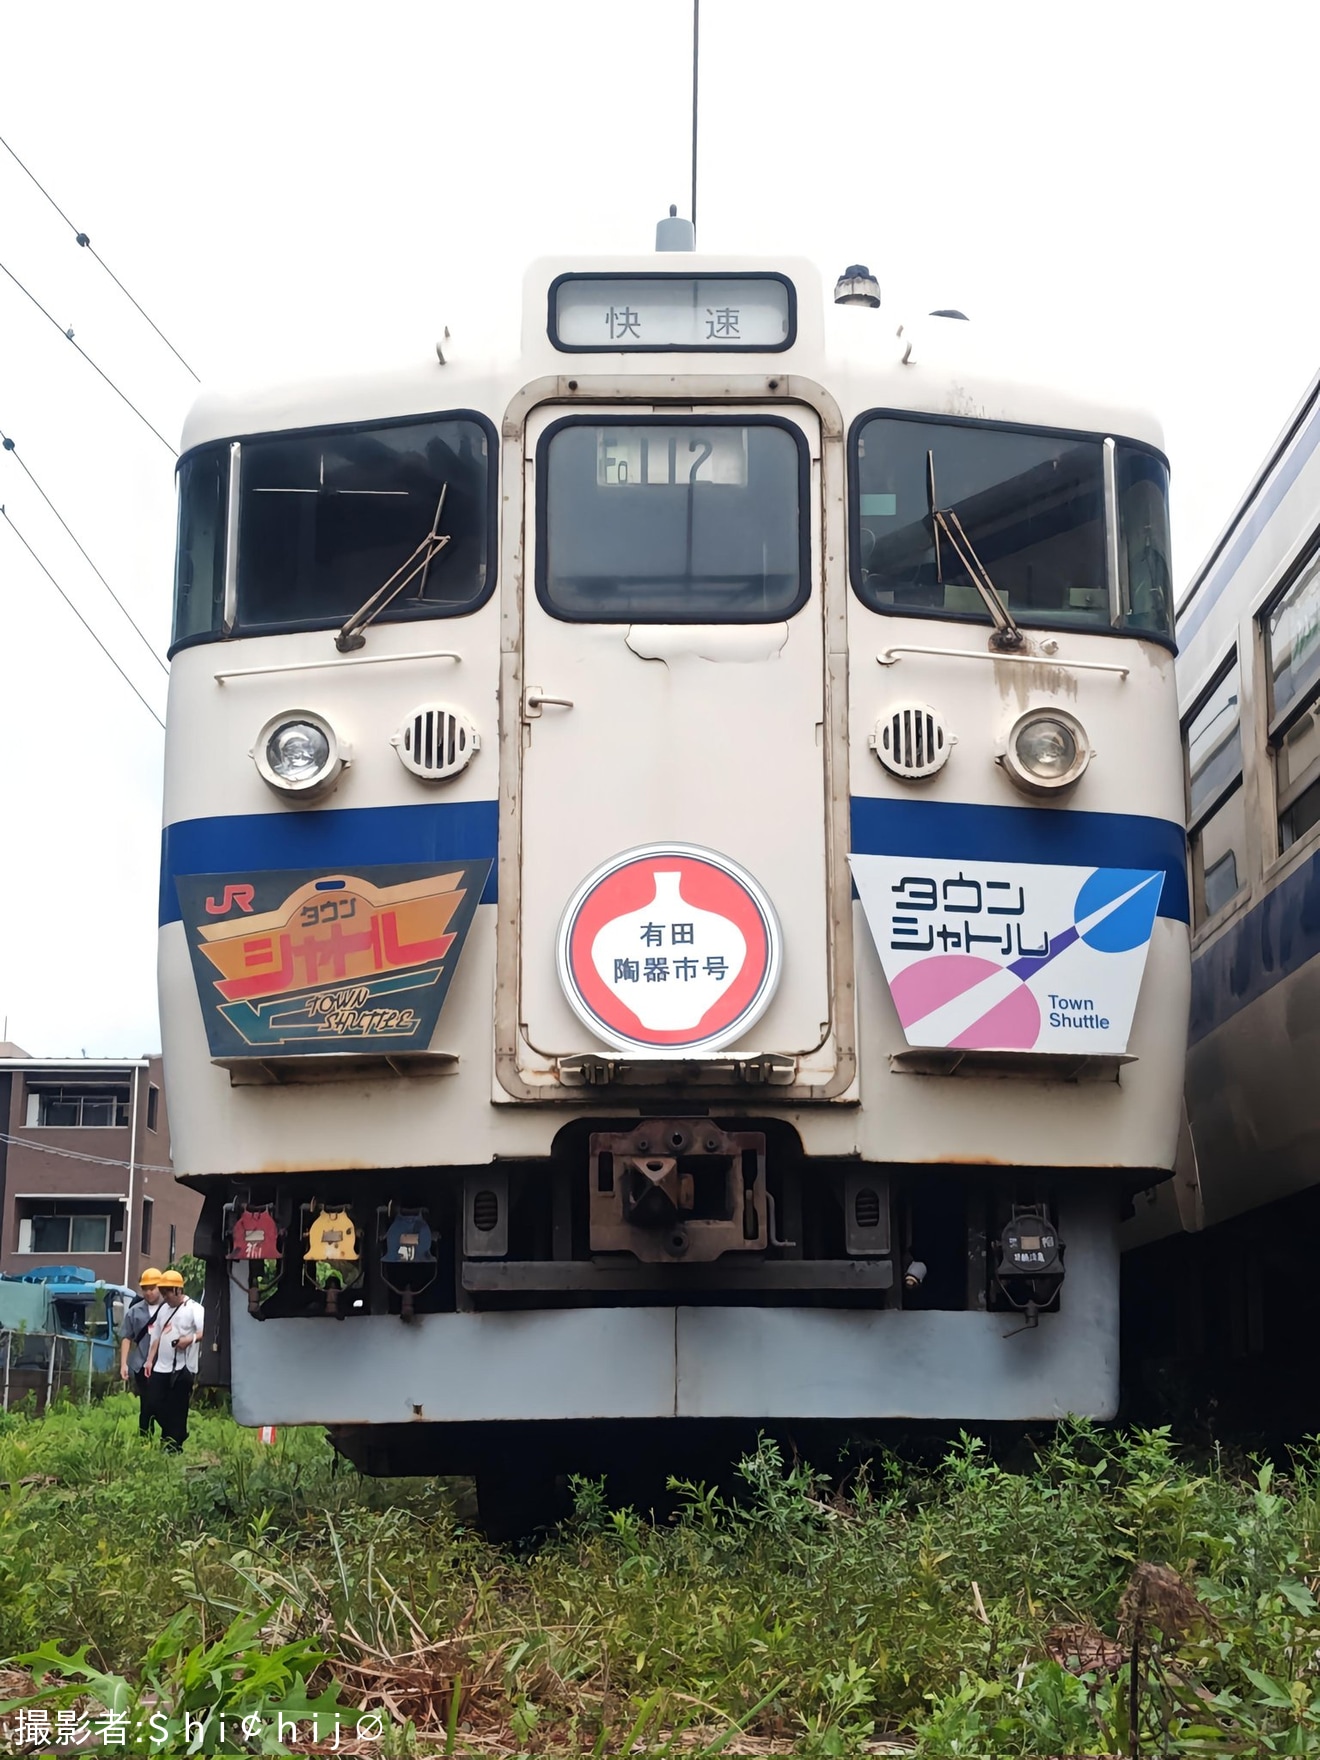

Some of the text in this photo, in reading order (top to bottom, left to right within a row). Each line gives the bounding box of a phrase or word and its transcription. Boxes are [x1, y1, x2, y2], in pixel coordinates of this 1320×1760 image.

[605, 306, 741, 340] 快速
[205, 884, 255, 915] JR
[891, 871, 1024, 915] タウン
[300, 897, 356, 927] タウン
[640, 922, 695, 948] 有田
[890, 916, 1049, 957] シャトル
[614, 956, 729, 983] 陶器市号
[306, 987, 369, 1017] TOWN
[1048, 994, 1094, 1011] Town
[1049, 1012, 1110, 1030] Shuttle
